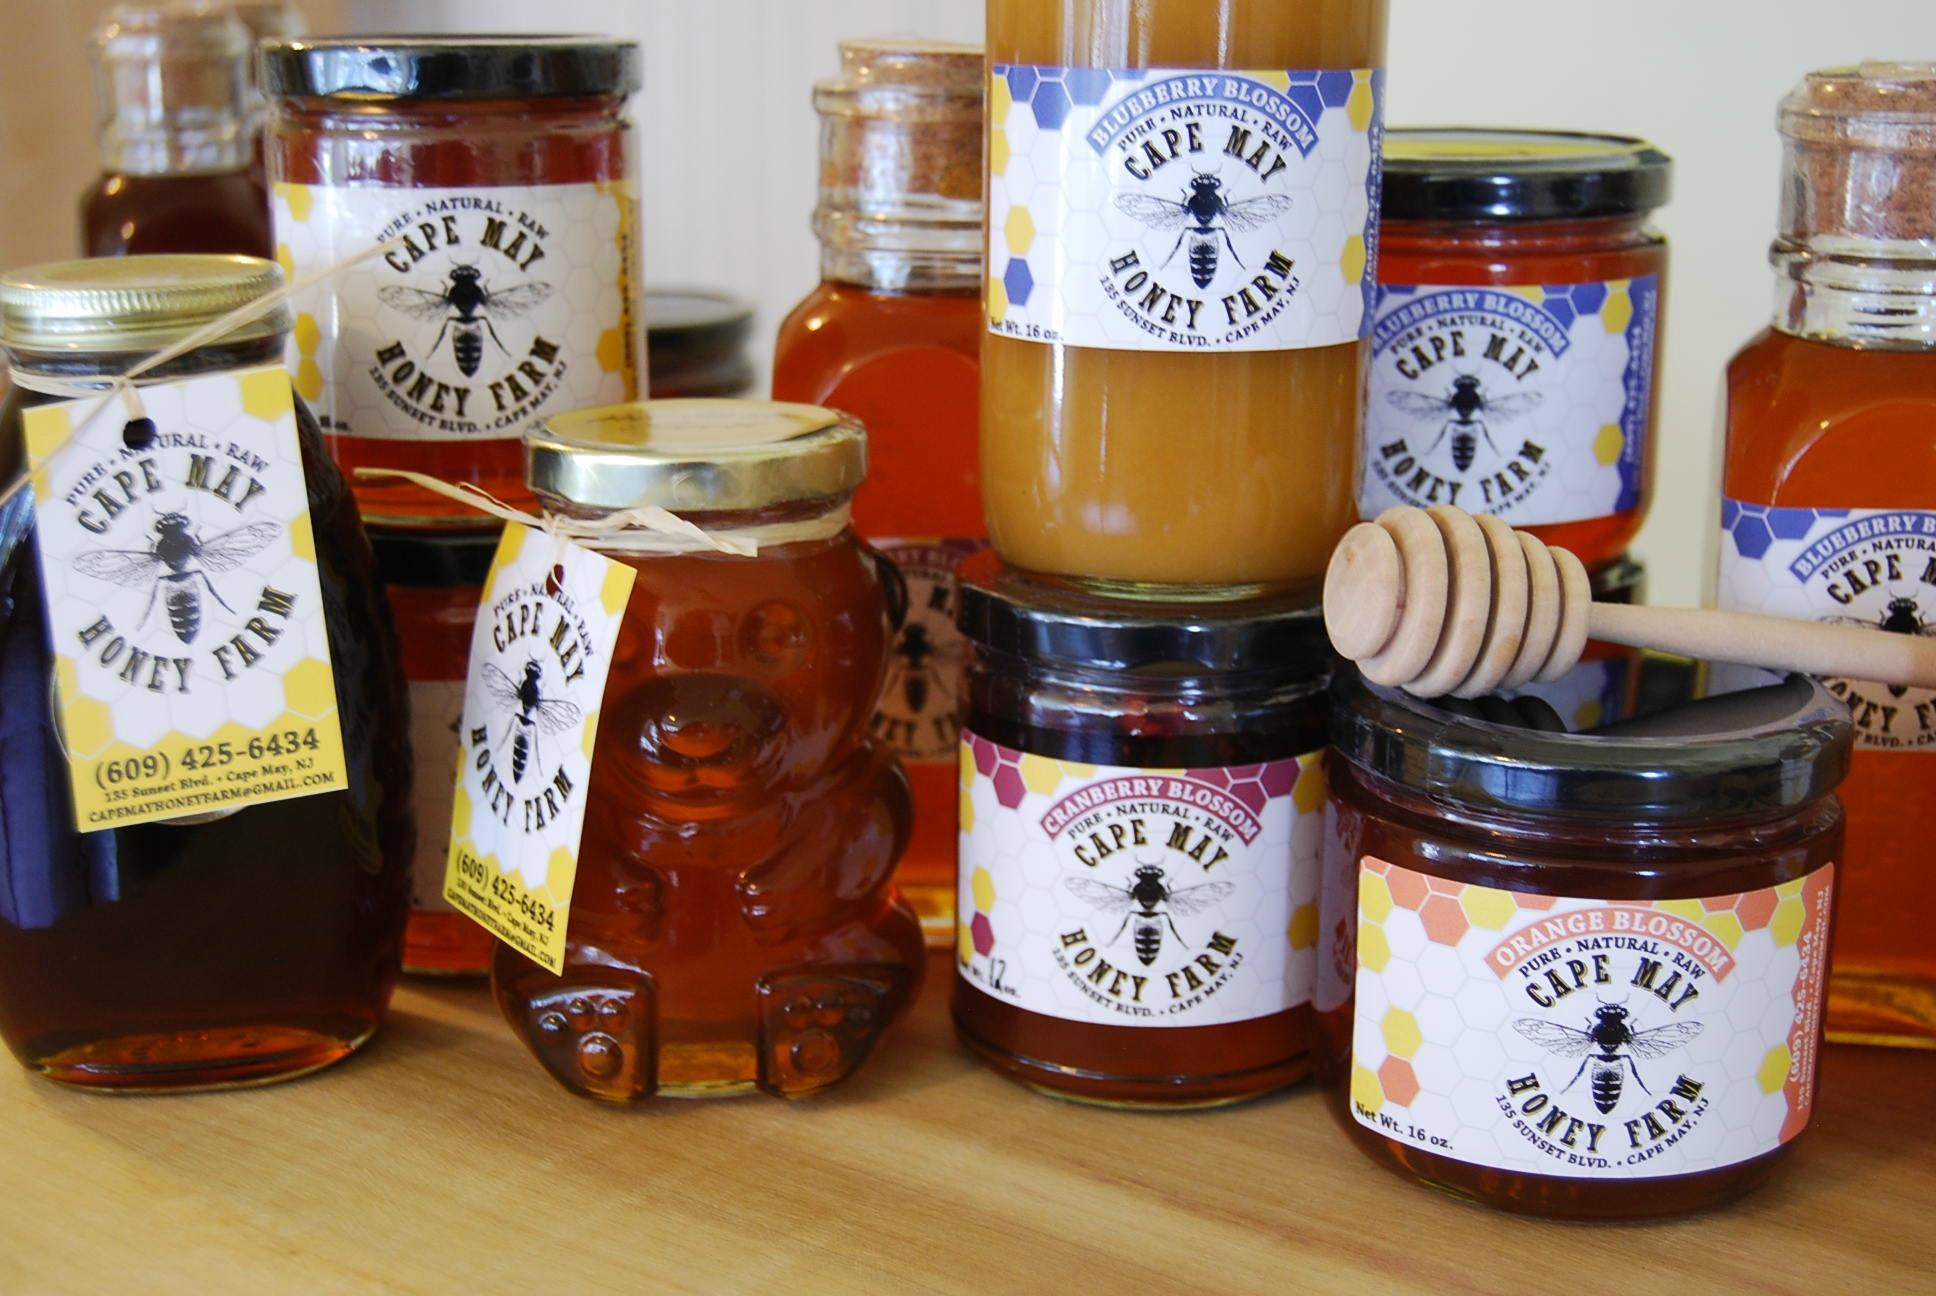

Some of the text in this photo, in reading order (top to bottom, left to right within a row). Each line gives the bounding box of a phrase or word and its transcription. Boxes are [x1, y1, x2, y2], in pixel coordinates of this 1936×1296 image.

[1092, 76, 1318, 150] BLUEBERRY BLOSSOM
[1117, 103, 1293, 151] PURE NATURAL RAW
[1123, 122, 1288, 184] CAPE MAY
[377, 196, 550, 243] PURE NATURAL RAW
[384, 216, 546, 273] CAPE MAY
[1100, 275, 1119, 301] 135
[1117, 299, 1166, 339] SUNSET
[1168, 330, 1211, 347] BLVD.
[1225, 321, 1261, 344] CAPE
[1109, 248, 1296, 331] HONEY FARM
[1026, 324, 1040, 338] 16
[1374, 292, 1566, 350] BLUEBERRY BLOSSOM
[376, 336, 560, 417] HONEY FARM
[1396, 330, 1540, 382] CAPE MAY
[439, 415, 481, 432] BLVD.
[495, 406, 530, 429] CAPE
[66, 463, 107, 507] PURE
[225, 443, 270, 472] RAW
[78, 453, 266, 535] CAPE MAY
[1380, 438, 1463, 505] HONEY
[1479, 439, 1546, 504] FARM
[1795, 515, 1917, 577] BLUEBERRY
[1821, 538, 1936, 579] PURE NATURA
[1827, 554, 1903, 604] CAPE
[78, 585, 300, 695] HONEY FARM
[493, 602, 585, 686] CAPE MAY
[1823, 676, 1898, 733] ONEY
[95, 728, 321, 790] (609) 425-6434
[132, 782, 176, 798] Sunset
[226, 770, 258, 785] Cape
[296, 757, 315, 770] NJ
[469, 723, 574, 834] HONEY FARM
[1045, 778, 1260, 838] CRANBERRY BLOSSOM
[1068, 801, 1235, 844] PURE NATURAL RAW
[1073, 818, 1229, 873] CAPE MAY
[457, 849, 489, 892] (609)
[492, 875, 554, 932] 425-6434
[1060, 927, 1239, 1002] HONEY FARM
[1496, 911, 1729, 973] ORANGE BLOSSOM
[1519, 937, 1706, 979] PURE NATURAL RAW
[1067, 970, 1113, 1010] SUNSET
[1115, 1001, 1156, 1018] BLVD.
[1169, 995, 1205, 1016] CAPE
[1525, 954, 1701, 1014] CAPE MAY
[1795, 931, 1812, 1026] 425-6434
[1355, 1101, 1454, 1151] Net Wt. 16 oz.
[1496, 1094, 1711, 1169] 135 SUNSET BLVD. CAPE MAY, NJ
[1506, 1072, 1705, 1154] HONEY FARM
